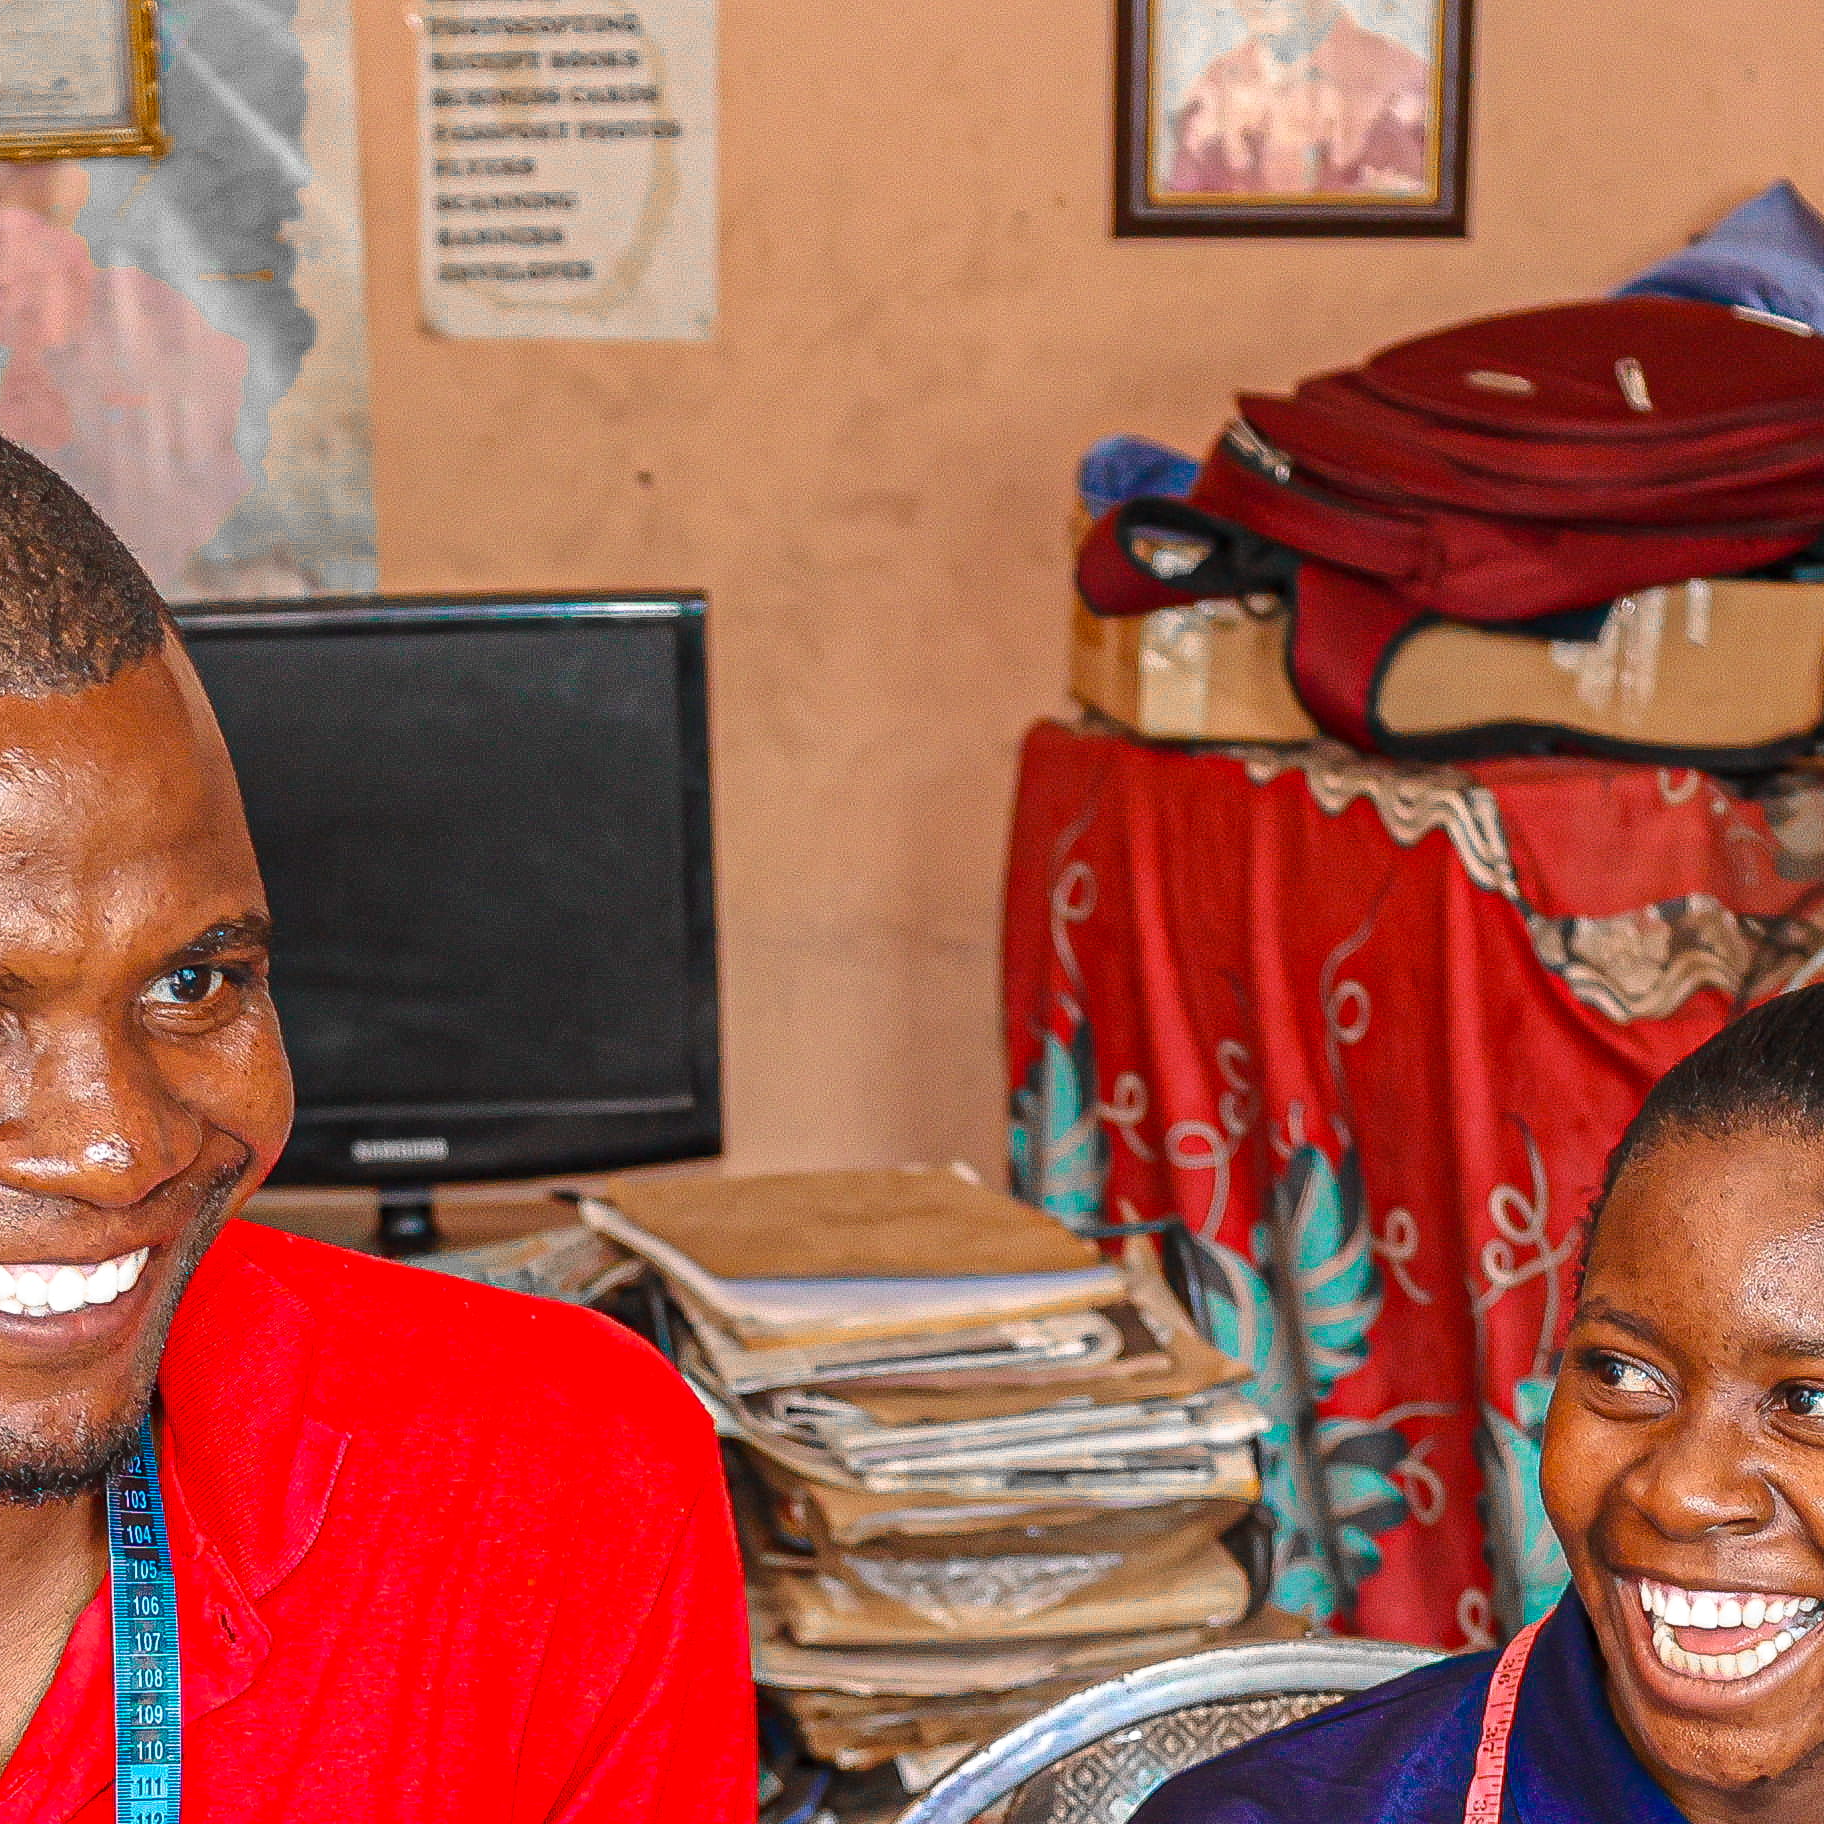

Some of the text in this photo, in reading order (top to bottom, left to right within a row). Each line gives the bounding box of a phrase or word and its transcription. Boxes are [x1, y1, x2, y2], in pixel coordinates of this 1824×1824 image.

[124, 1491, 147, 1509] 103
[126, 1525, 151, 1544] 104
[132, 1561, 157, 1579] 105
[133, 1597, 159, 1616] 106
[136, 1633, 161, 1652] 107
[136, 1669, 162, 1688] 108
[137, 1705, 163, 1724] 109
[137, 1741, 162, 1760] 110
[136, 1777, 161, 1795] 111
